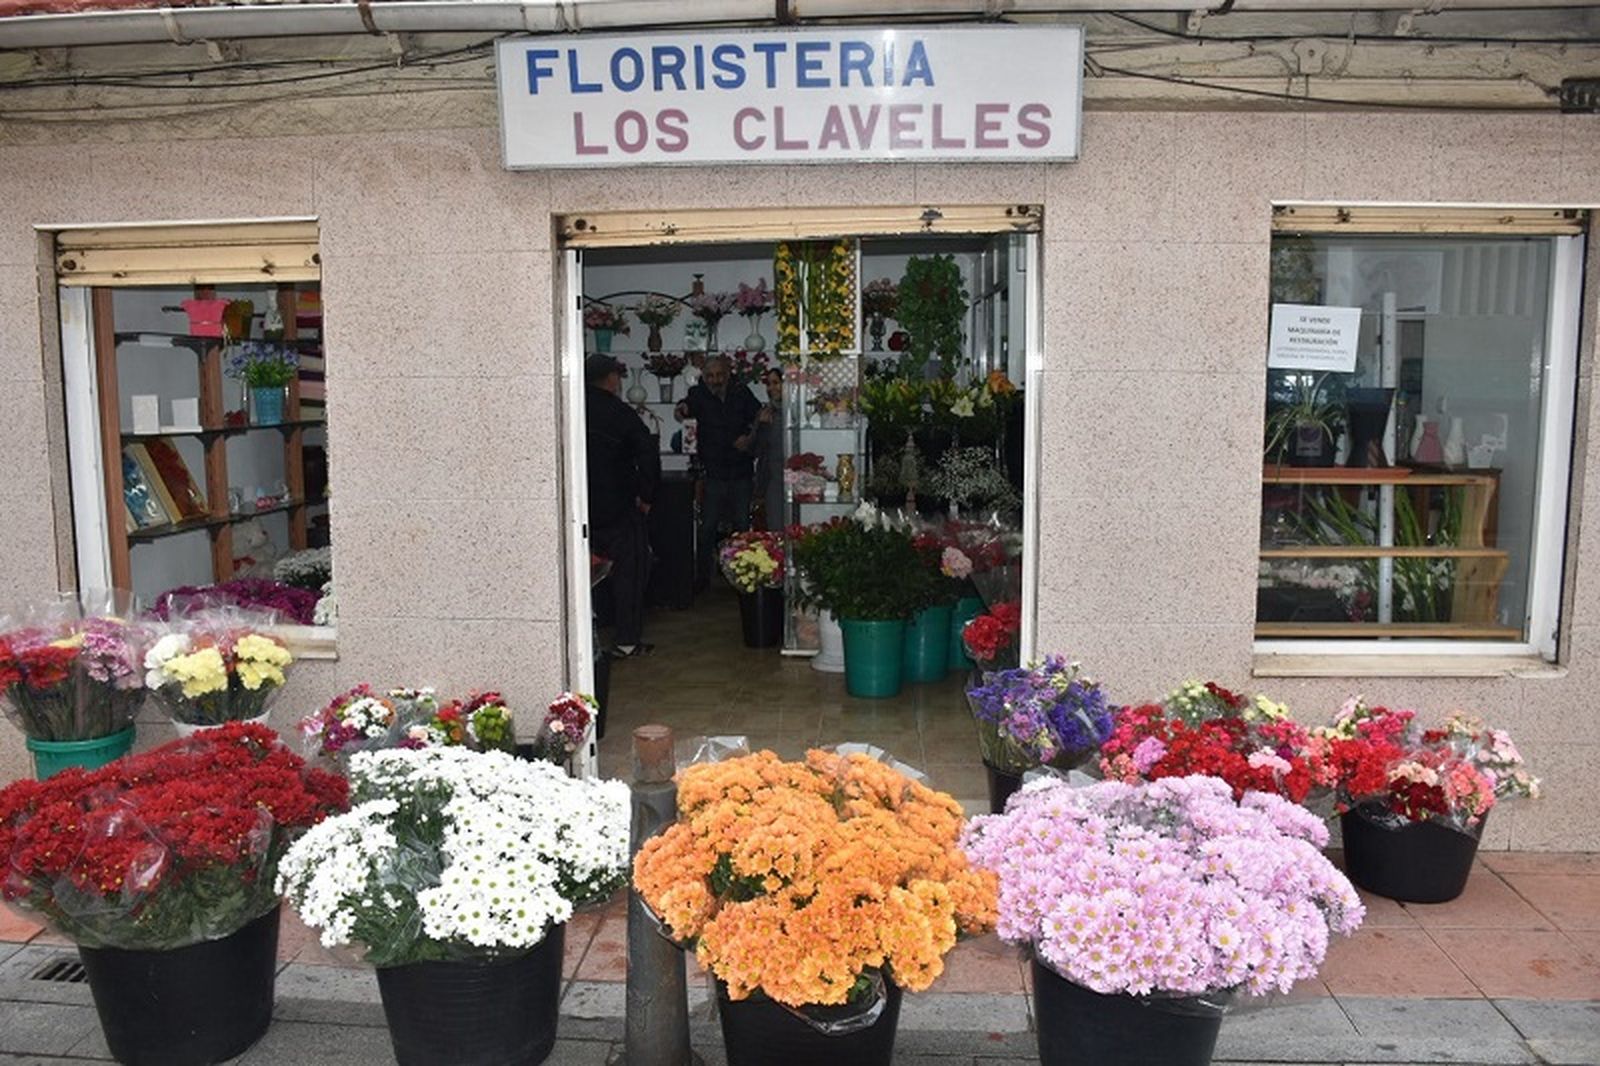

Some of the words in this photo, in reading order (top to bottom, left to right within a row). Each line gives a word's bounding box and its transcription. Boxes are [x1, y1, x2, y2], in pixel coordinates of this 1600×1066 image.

[526, 38, 936, 96] FLORISTERIA
[573, 107, 690, 156] LOS
[733, 102, 1053, 152] CLAVELES
[1309, 316, 1331, 325] VENDE
[1332, 328, 1341, 336] DE
